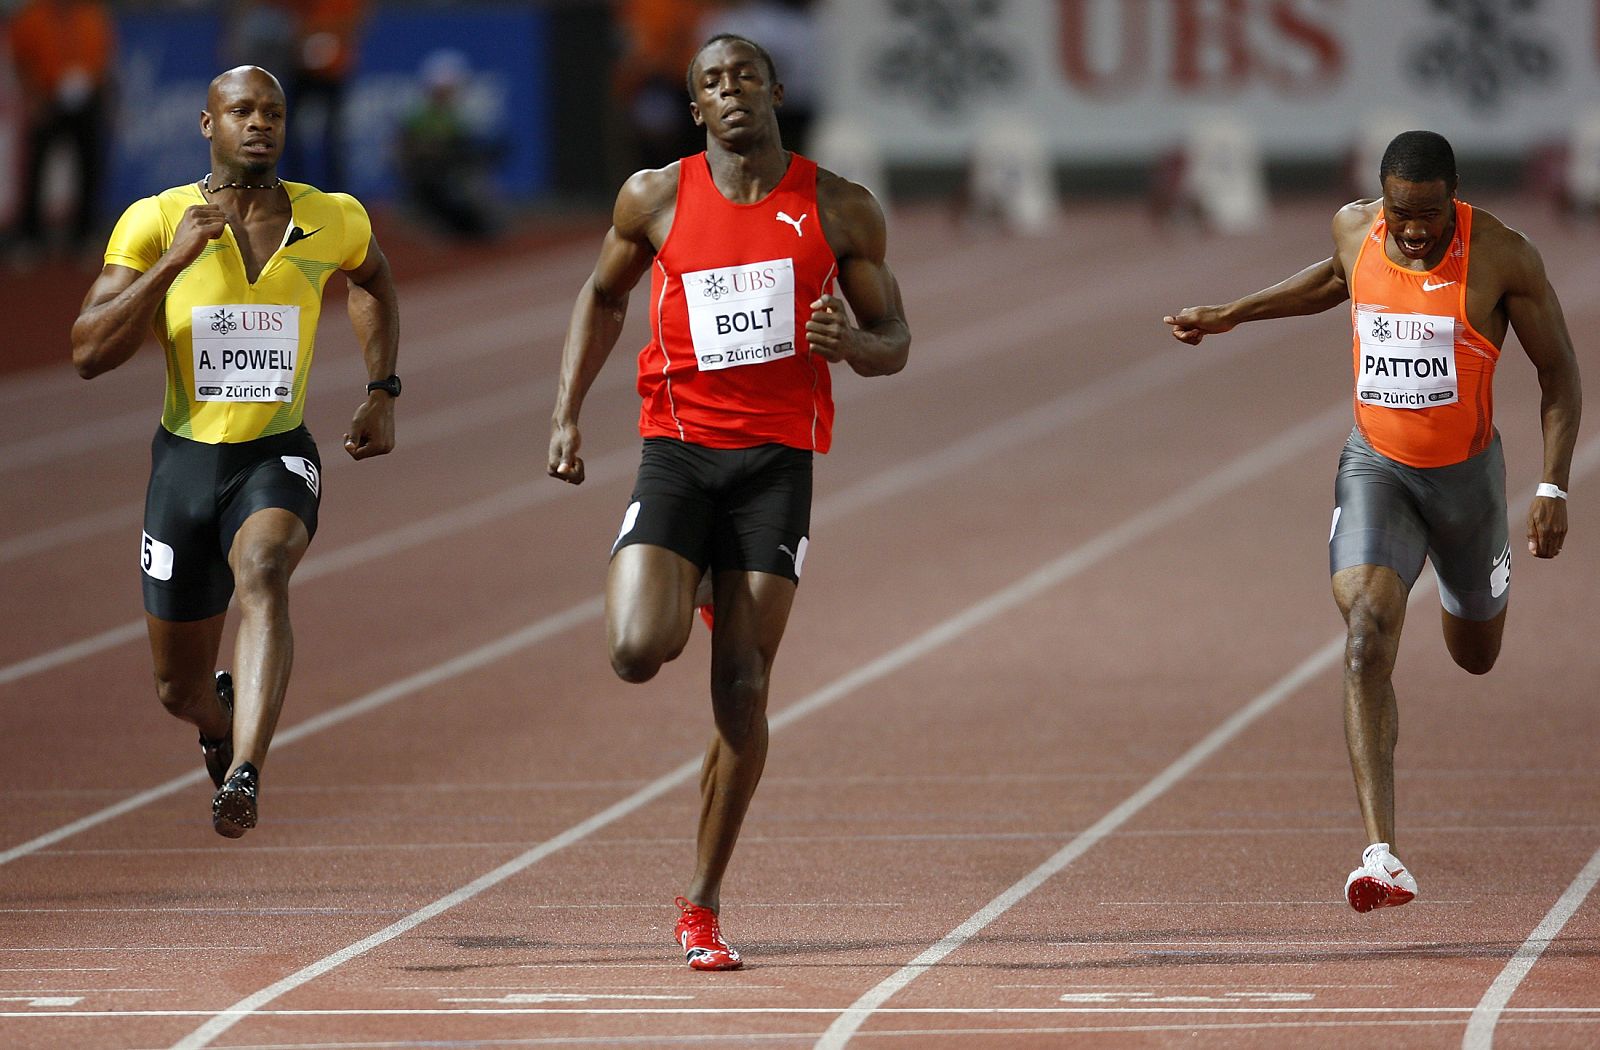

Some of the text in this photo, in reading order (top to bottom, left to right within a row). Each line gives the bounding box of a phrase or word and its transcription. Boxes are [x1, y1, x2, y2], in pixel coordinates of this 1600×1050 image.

[732, 268, 776, 293] UBS
[241, 310, 283, 332] UBS
[715, 307, 774, 335] BOLT
[1395, 320, 1435, 341] UBS
[198, 349, 293, 371] A. POWELL
[726, 346, 771, 363] Zürich
[1365, 354, 1449, 378] PATTON
[225, 385, 271, 398] Zürich
[1383, 392, 1425, 405] Zürich
[143, 537, 153, 571] 5
